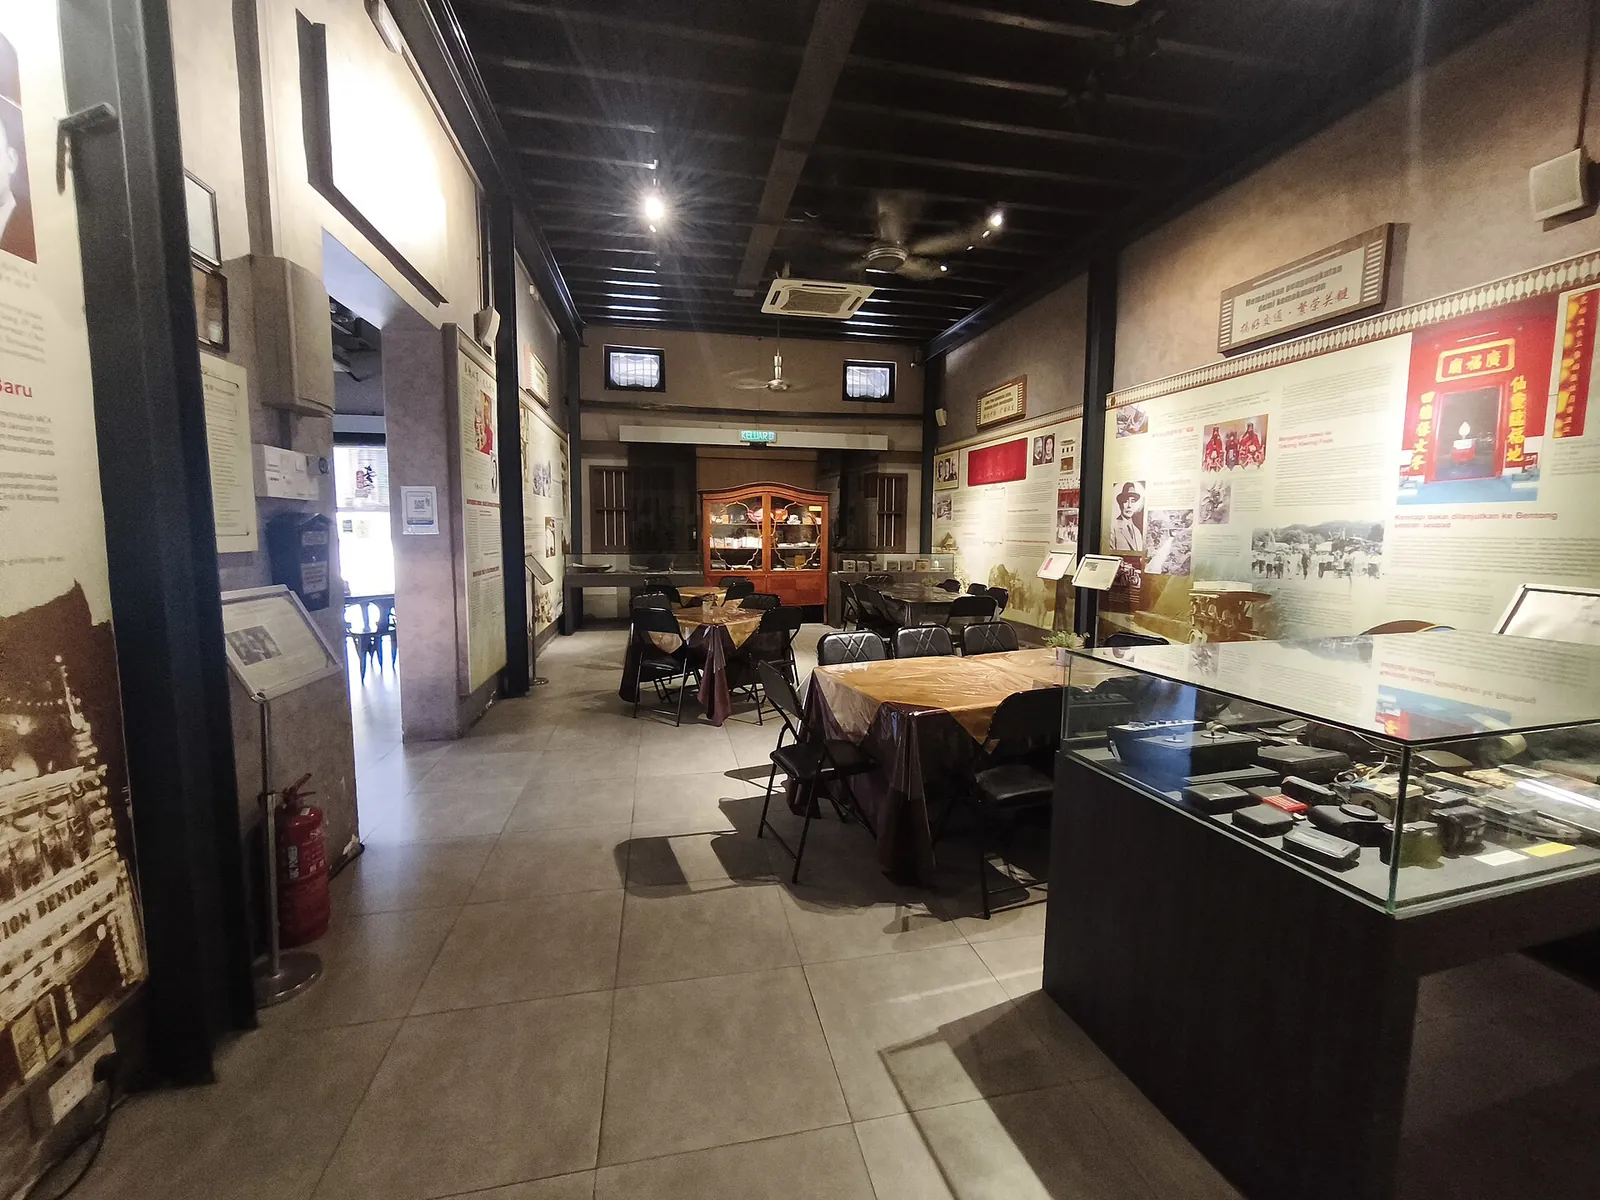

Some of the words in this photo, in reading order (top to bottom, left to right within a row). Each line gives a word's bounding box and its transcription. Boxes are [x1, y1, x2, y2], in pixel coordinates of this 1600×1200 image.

[1286, 265, 1343, 294] pengangkutan
[740, 430, 768, 440] KELUAR
[1502, 512, 1513, 520] ke
[1515, 511, 1558, 521] Bentong
[36, 870, 99, 919] BENTONG
